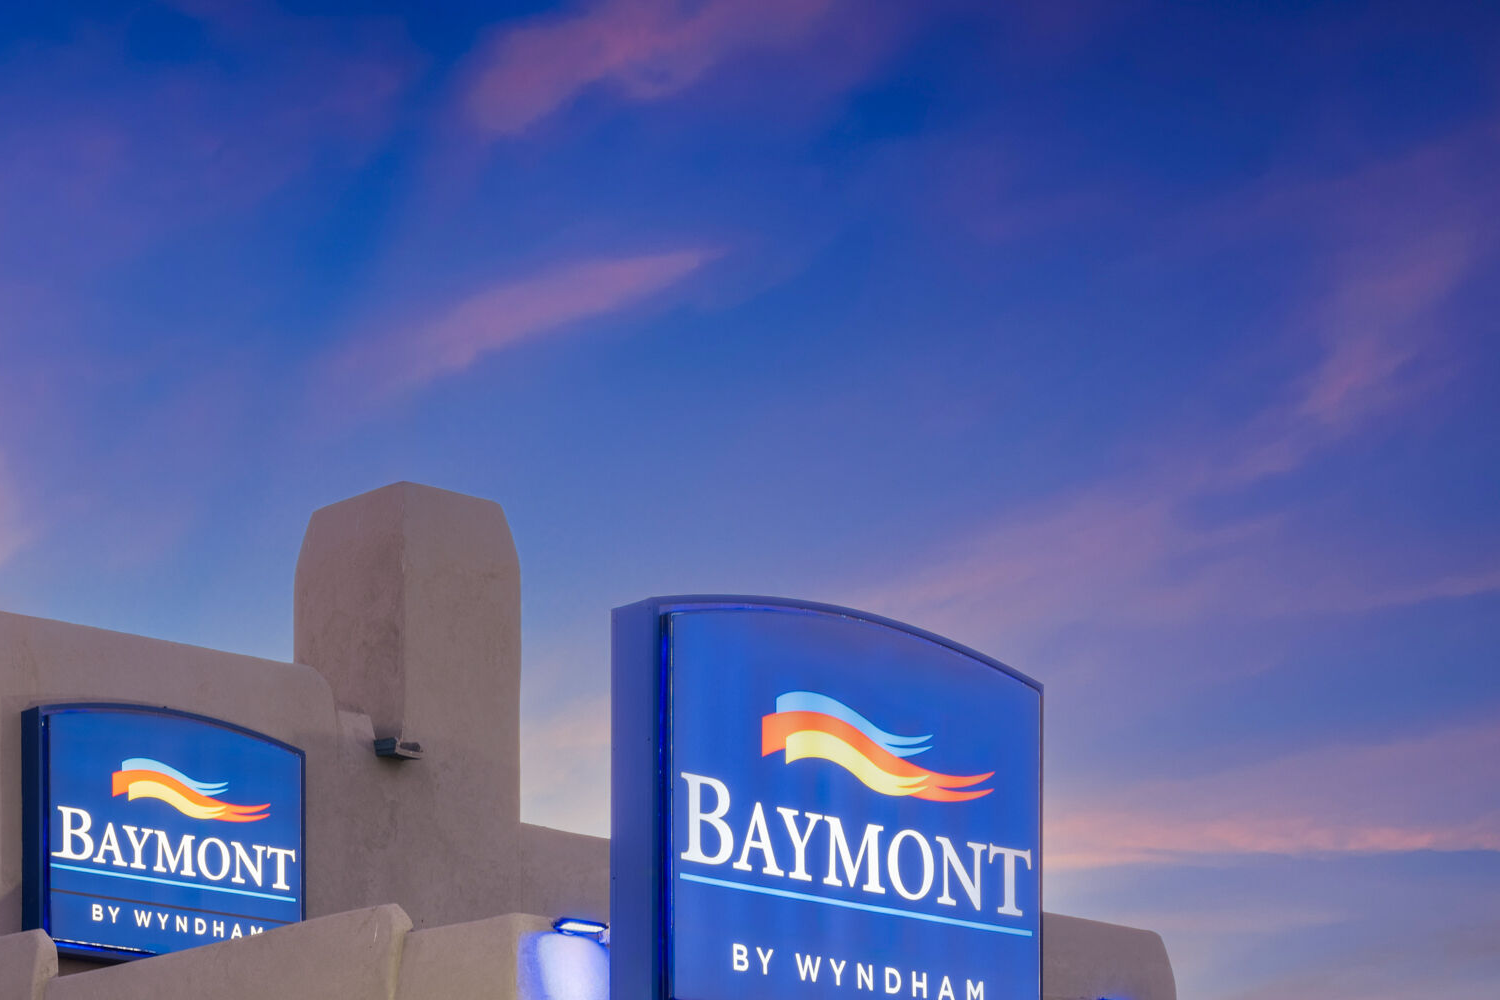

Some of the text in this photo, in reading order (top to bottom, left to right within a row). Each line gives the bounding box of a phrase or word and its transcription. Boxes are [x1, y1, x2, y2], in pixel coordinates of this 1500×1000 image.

[51, 805, 296, 890] BAYMONT
[680, 771, 1032, 917] BAYMONT
[92, 903, 120, 923] BY
[732, 943, 774, 975] BY
